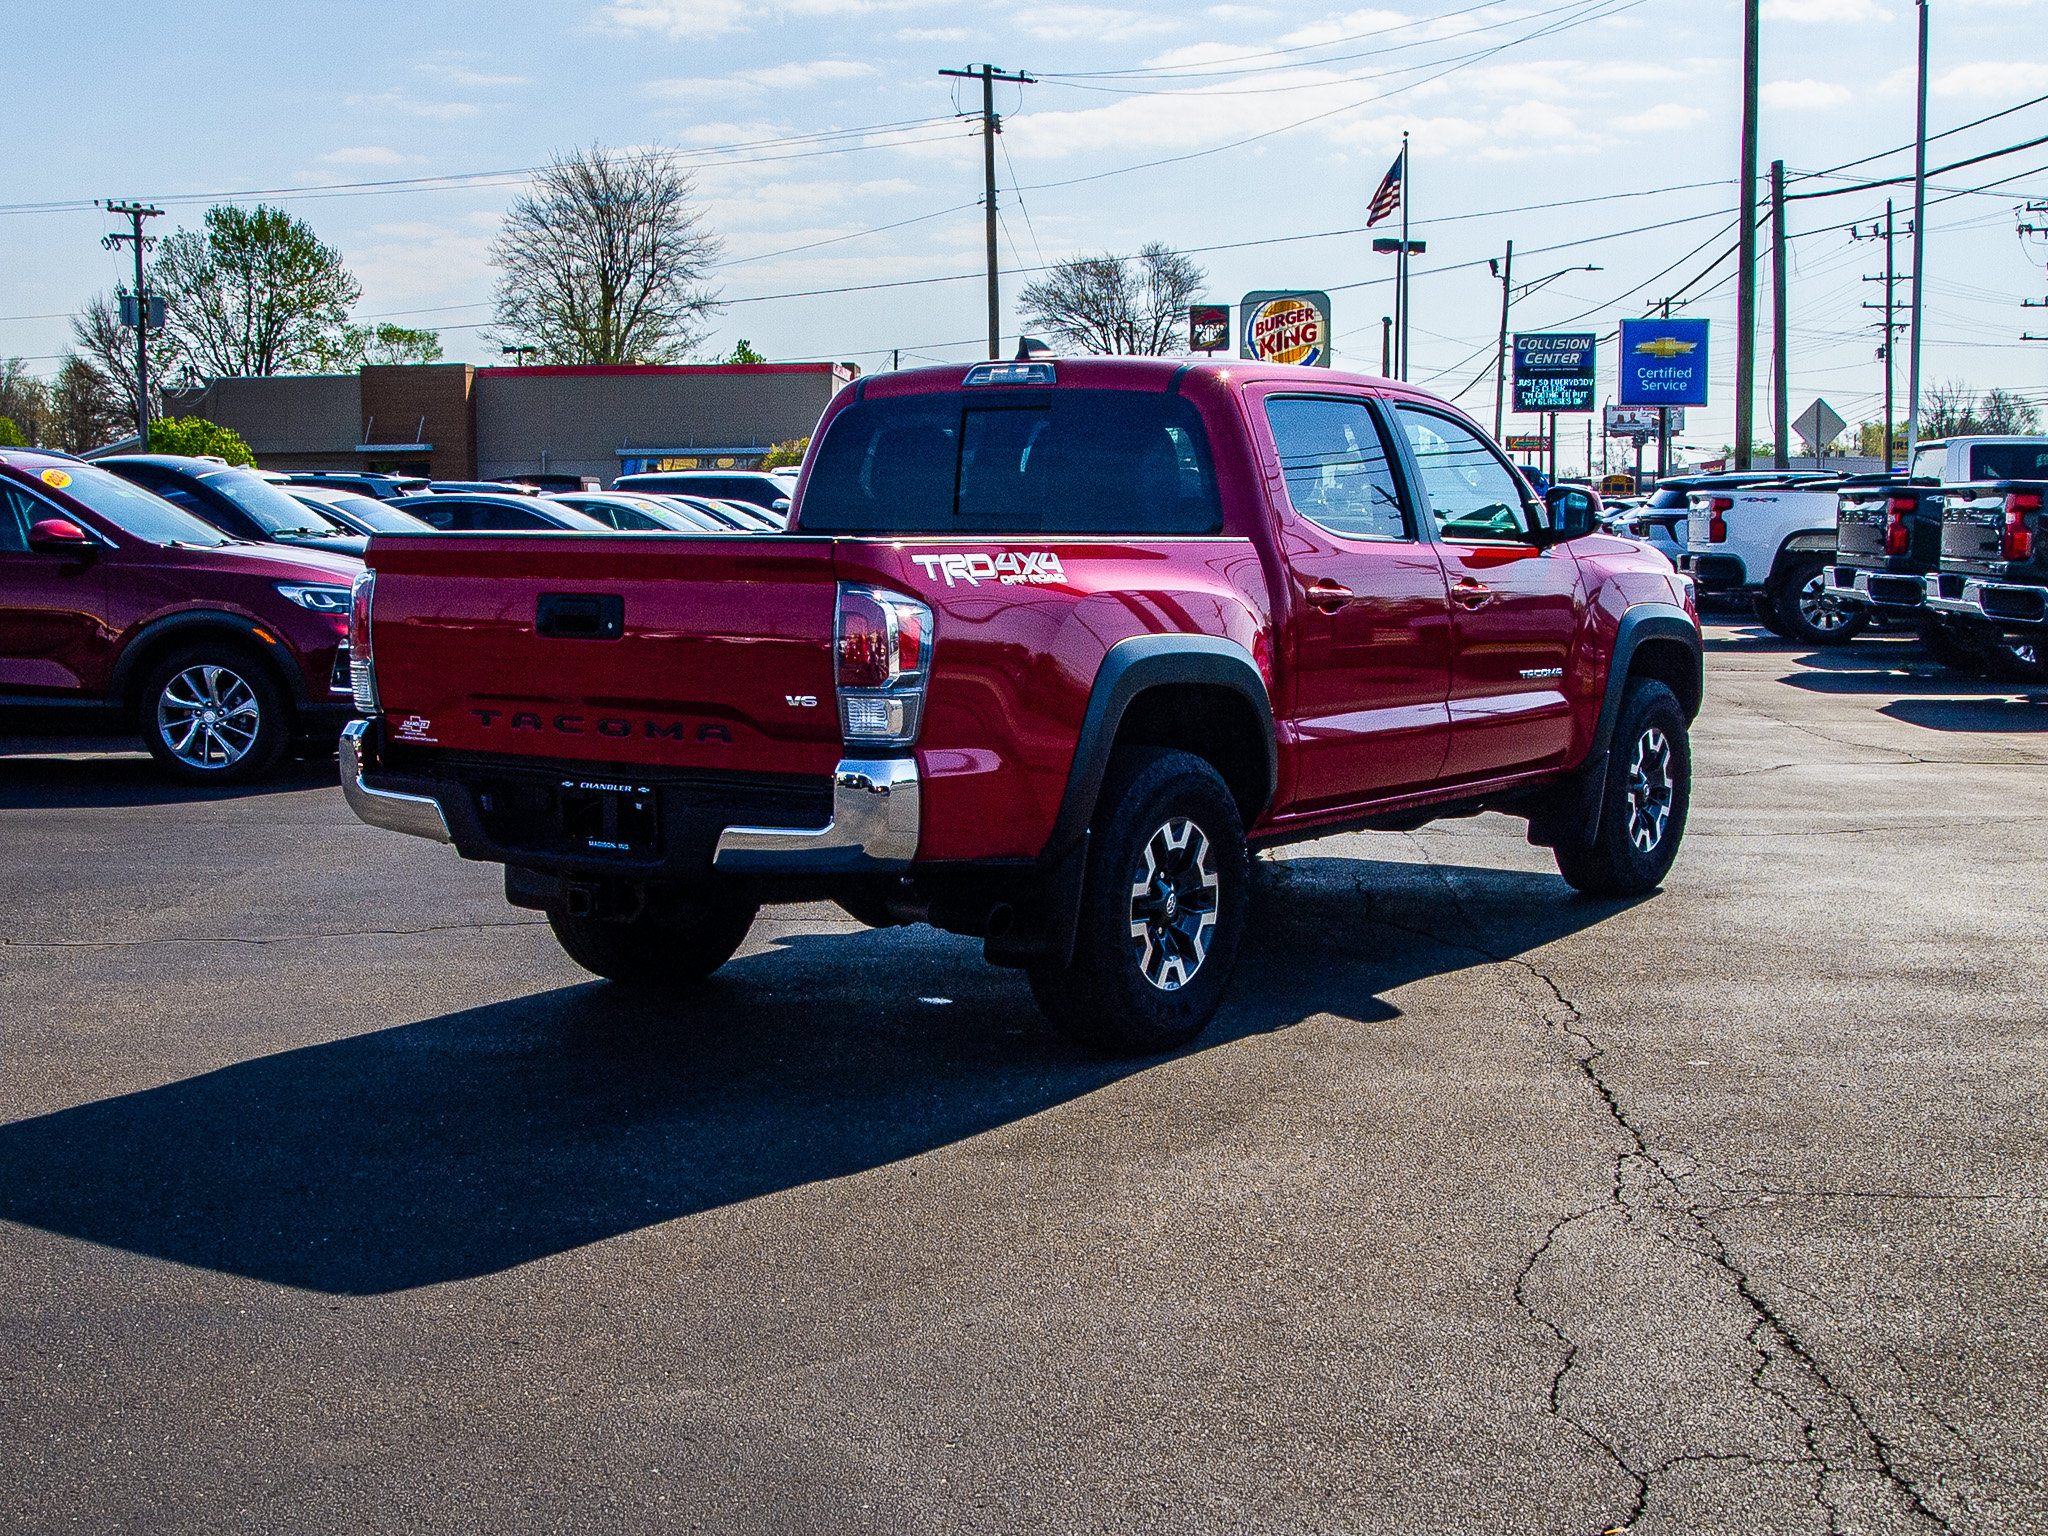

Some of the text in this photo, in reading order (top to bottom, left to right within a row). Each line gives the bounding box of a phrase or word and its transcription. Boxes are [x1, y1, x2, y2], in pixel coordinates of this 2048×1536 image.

[1255, 307, 1315, 338] BURGER
[1259, 323, 1318, 359] KING
[1518, 338, 1590, 350] COLLISION
[1524, 352, 1581, 365] CENTER
[1637, 367, 1693, 379] Certified
[1517, 378, 1537, 387] JUST
[1538, 378, 1549, 387] SO
[1641, 379, 1688, 391] Service
[911, 552, 1065, 588] TRD 4X4
[785, 695, 818, 708] V6
[470, 708, 733, 745] TACOMA
[580, 782, 633, 792] CHANDLER
